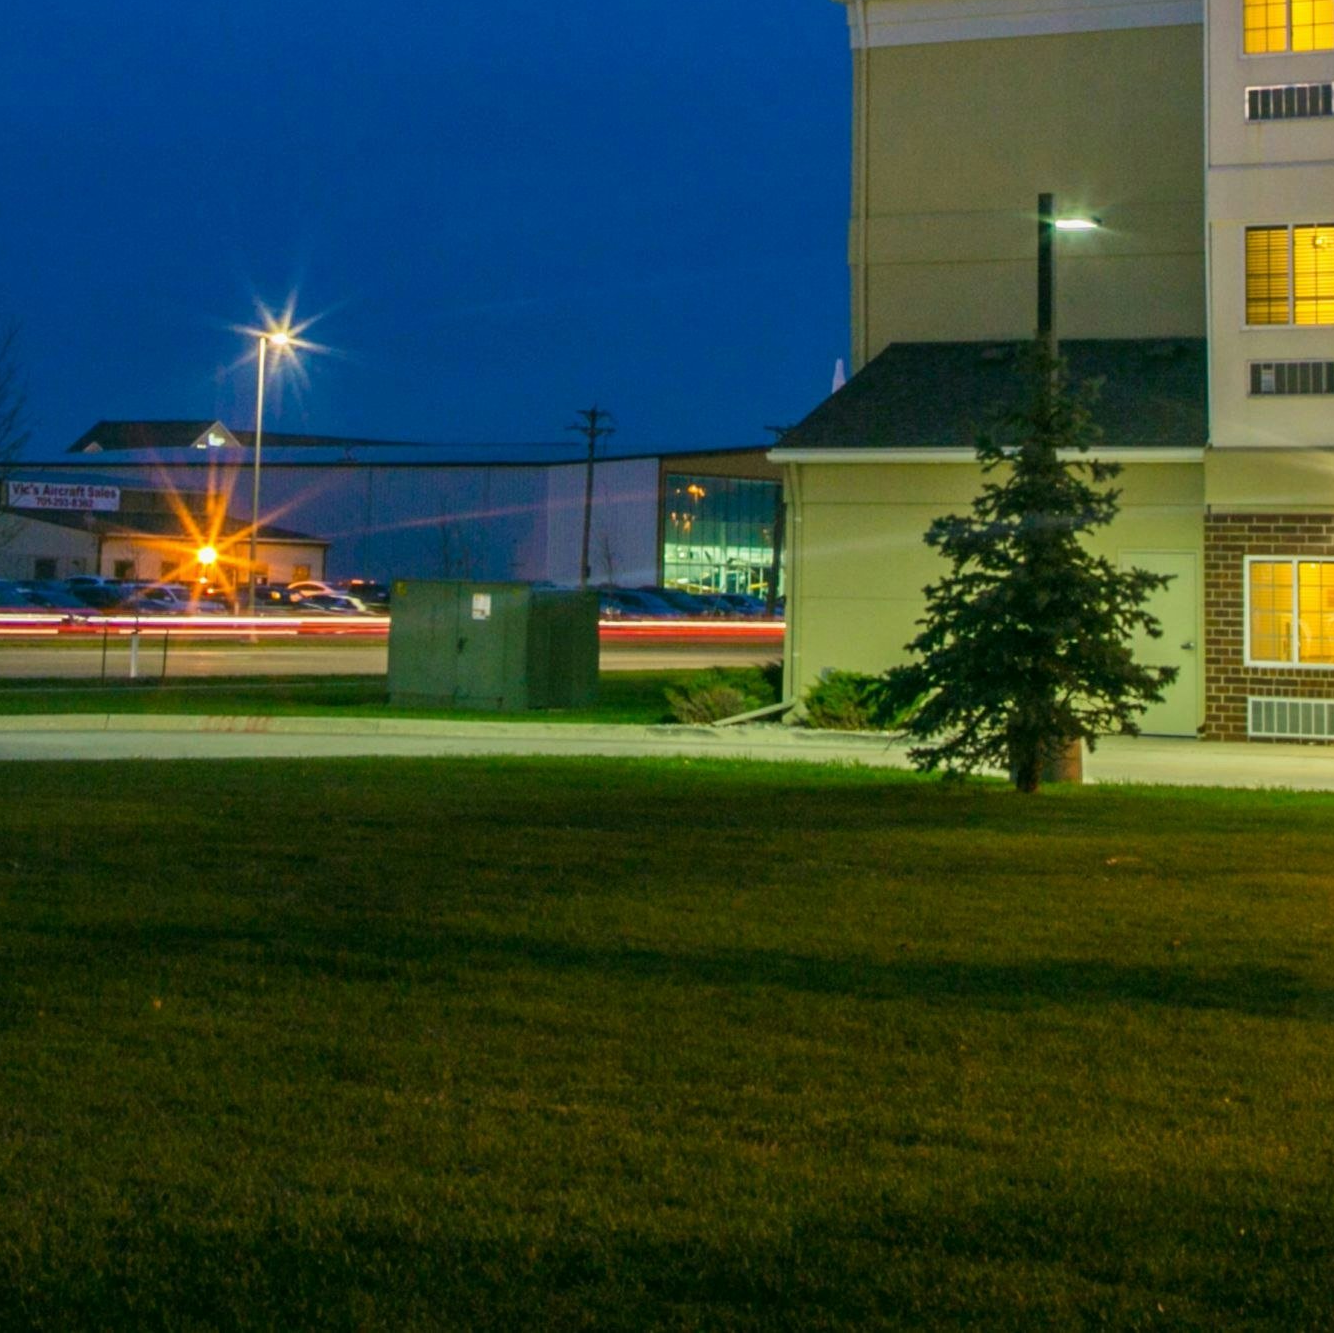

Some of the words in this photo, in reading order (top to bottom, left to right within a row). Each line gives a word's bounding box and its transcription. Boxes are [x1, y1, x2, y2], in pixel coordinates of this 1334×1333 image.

[12, 484, 39, 495] Vic's
[43, 484, 85, 497] Aircraft
[87, 486, 117, 499] Sales
